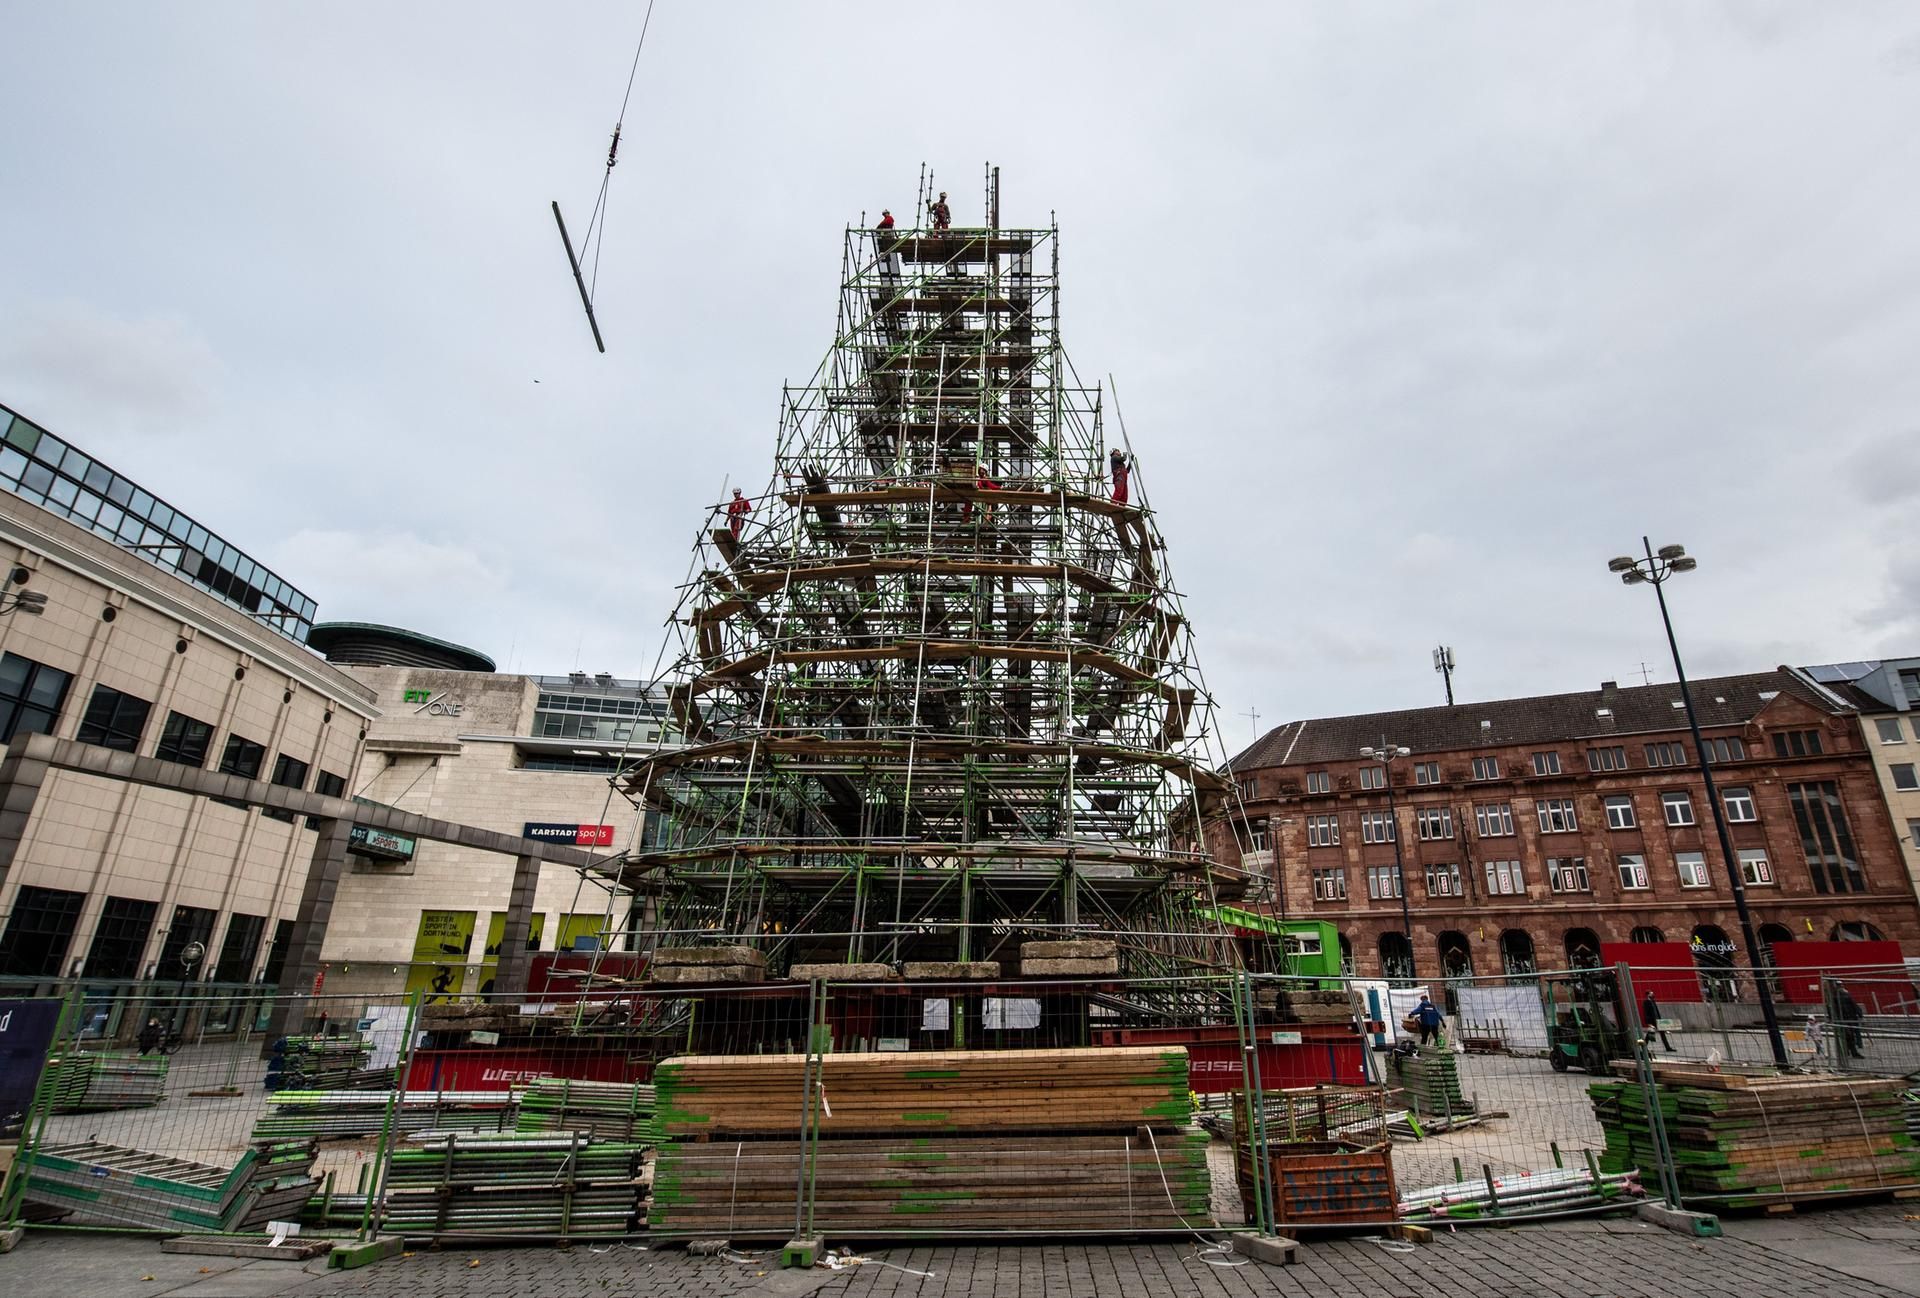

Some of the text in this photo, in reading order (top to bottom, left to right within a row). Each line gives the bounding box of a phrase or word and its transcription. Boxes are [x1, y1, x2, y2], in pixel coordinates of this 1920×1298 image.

[404, 690, 431, 703] FIT
[429, 702, 462, 717] ONE
[531, 828, 577, 837] KARSTADT
